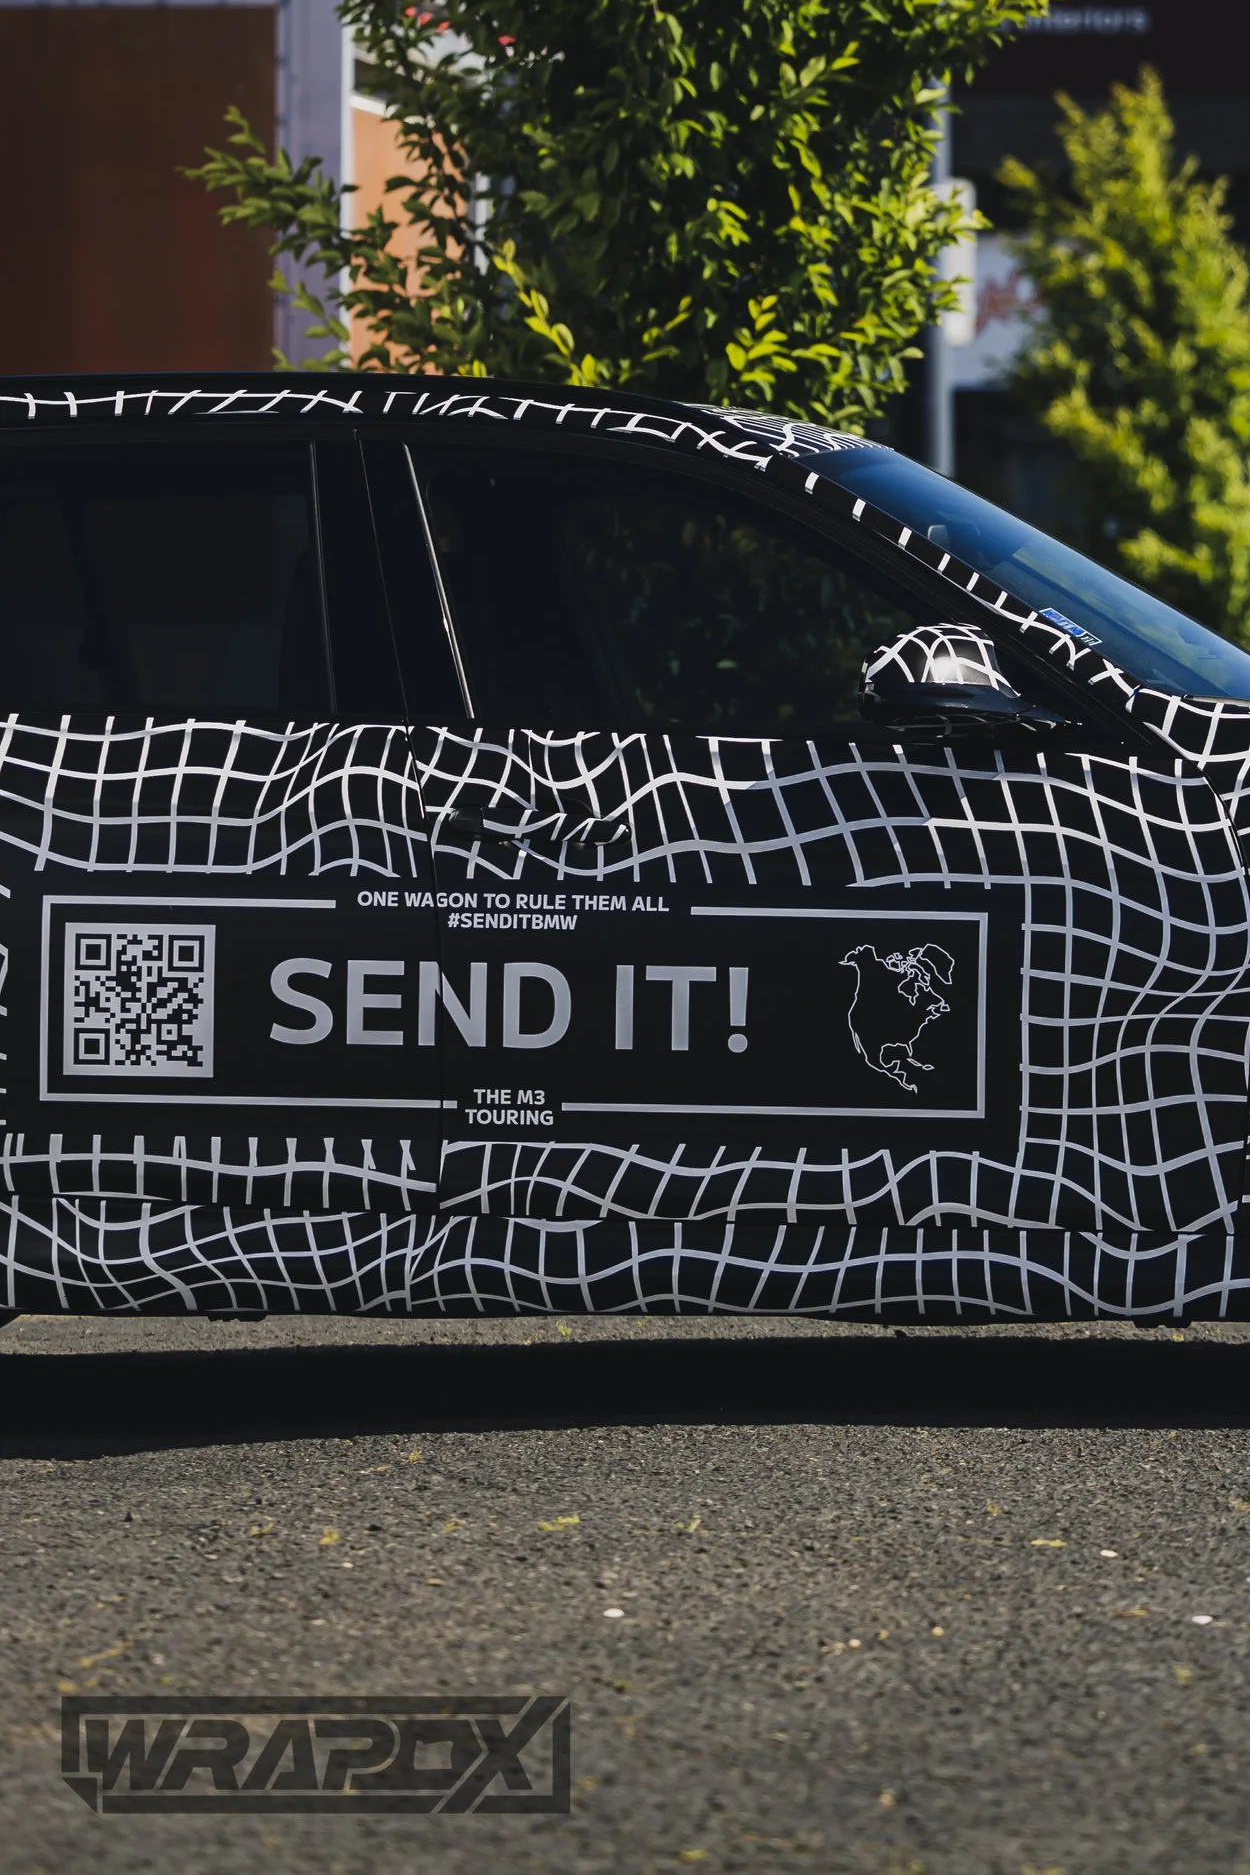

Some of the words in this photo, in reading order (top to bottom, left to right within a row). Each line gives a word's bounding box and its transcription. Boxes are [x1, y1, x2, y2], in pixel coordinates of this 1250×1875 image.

[357, 890, 399, 907] ONE
[403, 891, 478, 909] WAGON
[482, 892, 511, 909] TO
[515, 893, 567, 911] RULE
[571, 894, 627, 912] THEM
[631, 895, 670, 912] ALL
[447, 912, 578, 931] #SENDITBMW
[269, 957, 572, 1050] SEND
[614, 964, 750, 1053] IT!
[473, 1088, 512, 1106] THE
[516, 1089, 546, 1106] M3
[464, 1108, 554, 1126] TOURING
